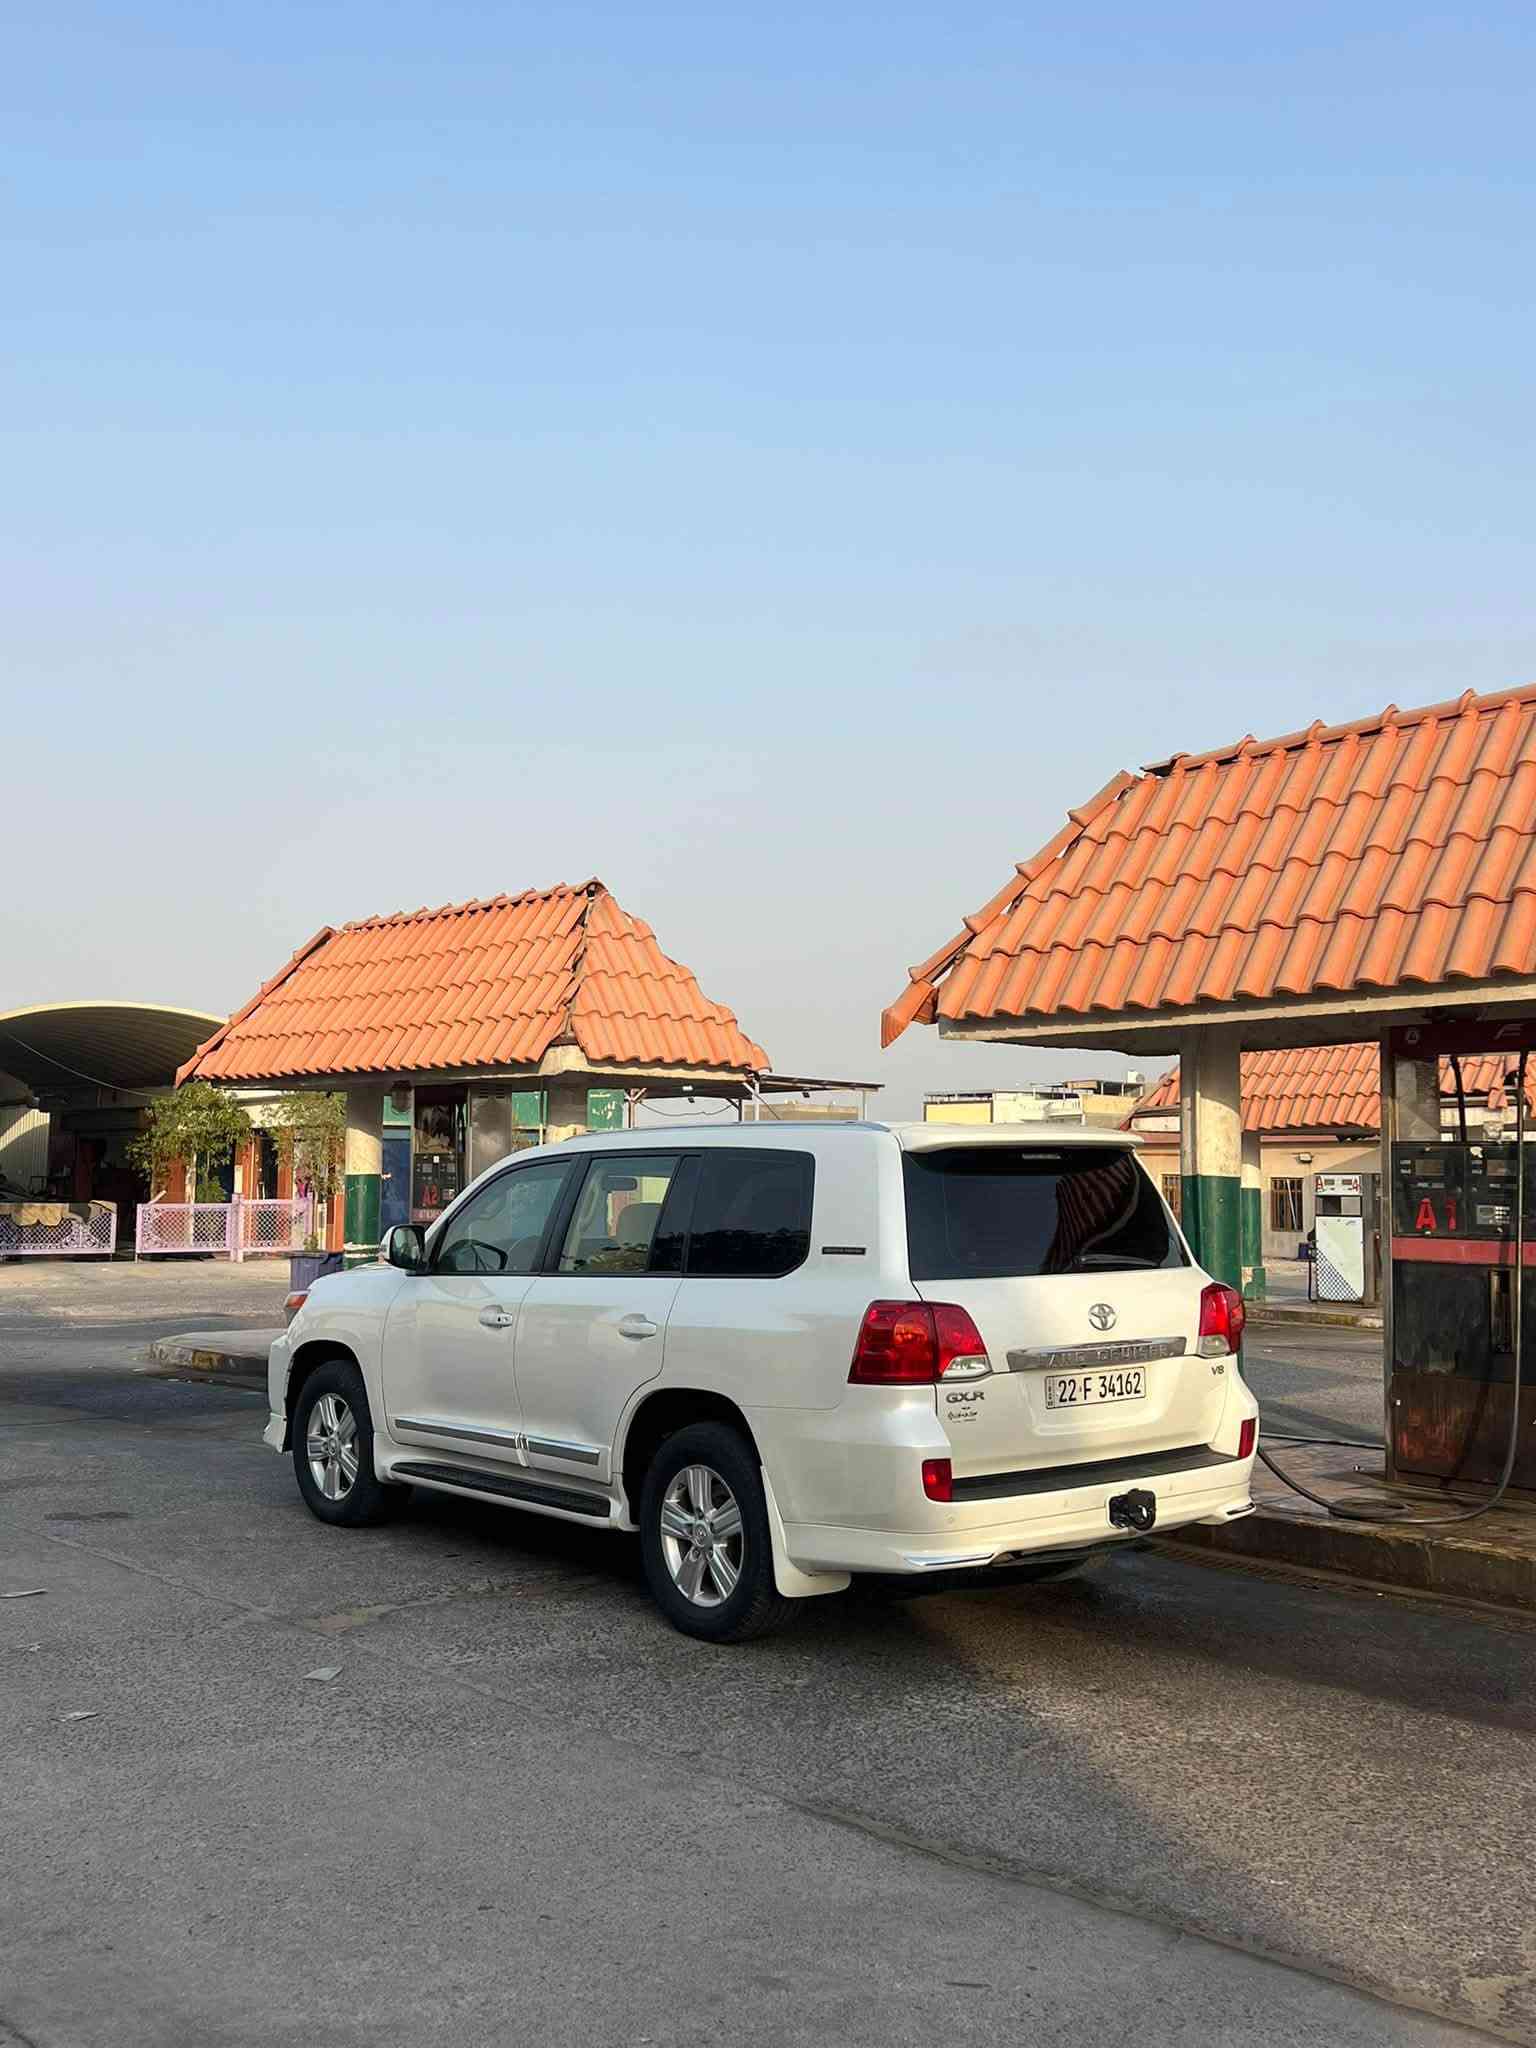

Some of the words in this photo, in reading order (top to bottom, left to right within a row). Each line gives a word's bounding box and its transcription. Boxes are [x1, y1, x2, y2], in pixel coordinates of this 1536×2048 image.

[1211, 1364, 1225, 1376] V8
[1058, 1379, 1077, 1402] 22
[1083, 1377, 1092, 1401] F
[1098, 1371, 1141, 1398] 34162
[946, 1391, 985, 1404] GXR
